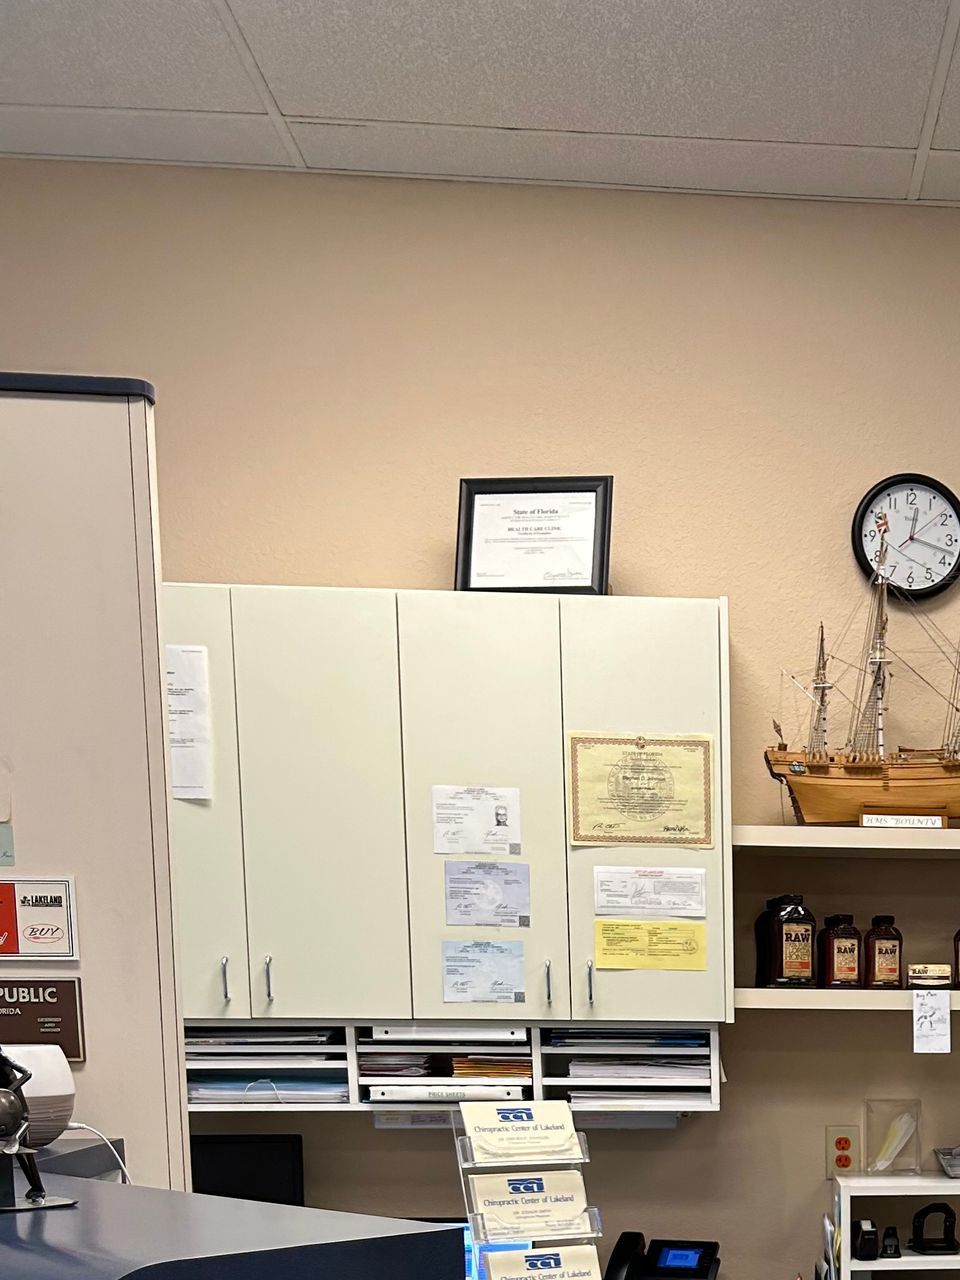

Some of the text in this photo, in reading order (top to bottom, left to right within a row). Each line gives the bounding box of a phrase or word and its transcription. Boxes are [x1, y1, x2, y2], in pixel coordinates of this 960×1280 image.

[889, 498, 897, 509] 11
[906, 493, 917, 505] 12
[940, 513, 948, 526] 2
[869, 530, 877, 542] 9
[945, 534, 954, 547] 3
[938, 555, 946, 567] 4
[889, 565, 897, 578] 7
[906, 571, 915, 584] 6
[924, 568, 933, 580] 5
[31, 895, 63, 904] LAKELAND
[29, 927, 60, 937] BUY
[784, 932, 811, 943] RAW
[836, 945, 856, 954] RAW
[878, 947, 897, 955] RAW
[473, 1125, 510, 1134] Chiropractic
[511, 1124, 530, 1132] Center
[540, 1123, 565, 1131] Lakeland
[483, 1198, 519, 1207] Chiropractic
[520, 1197, 541, 1205] Center
[549, 1194, 575, 1203] Lakeland
[538, 1273, 558, 1280] Center
[567, 1270, 592, 1279] Lakeland
